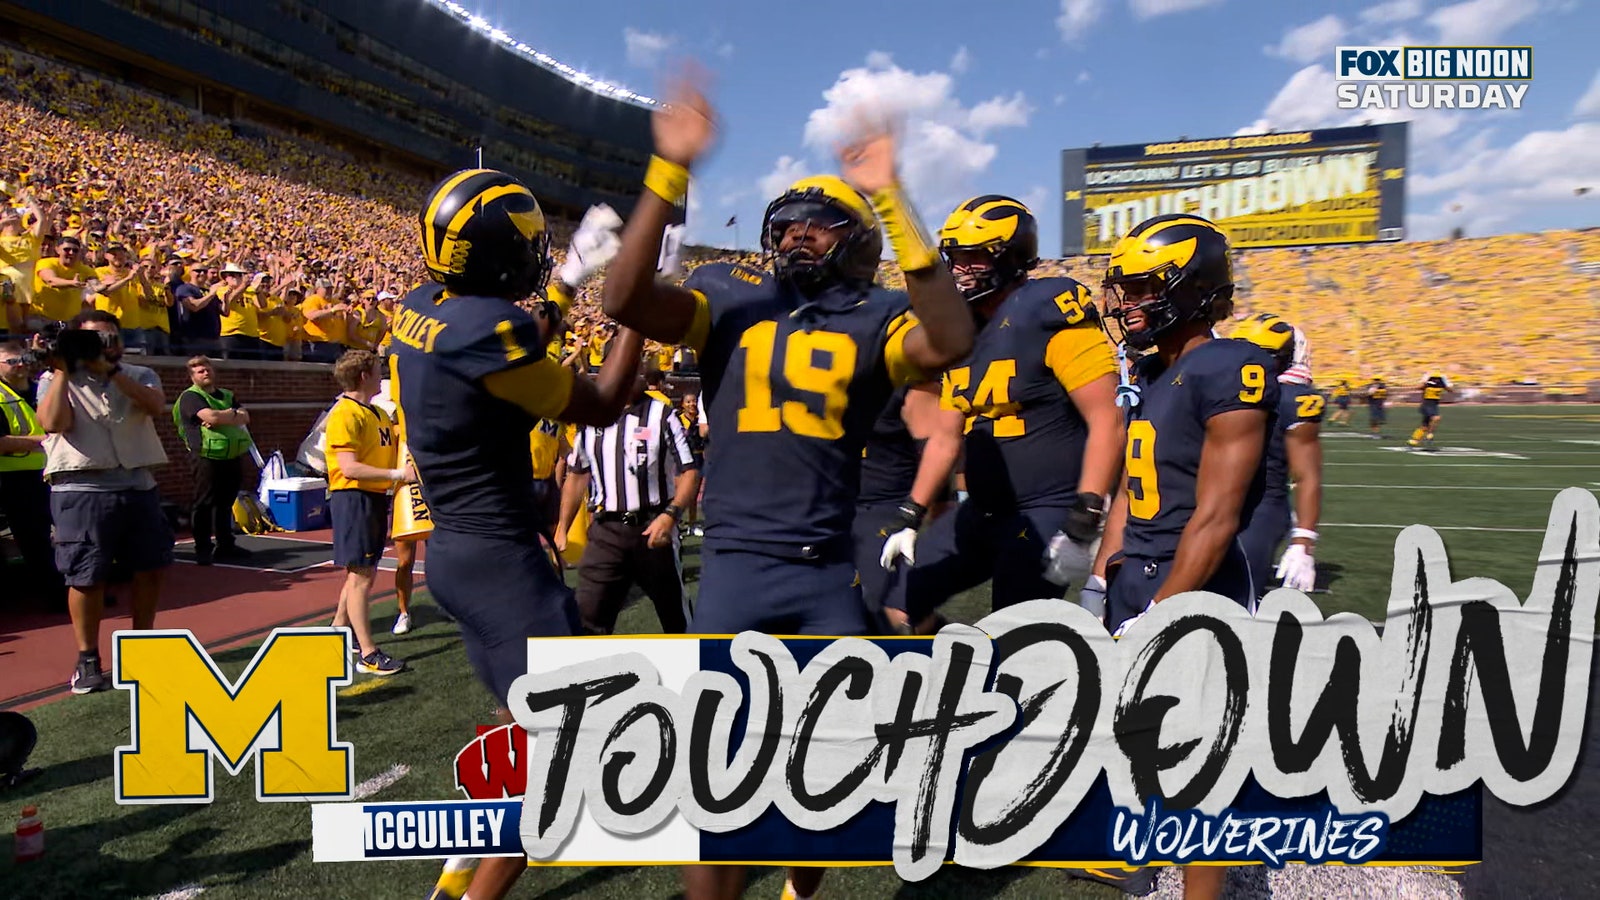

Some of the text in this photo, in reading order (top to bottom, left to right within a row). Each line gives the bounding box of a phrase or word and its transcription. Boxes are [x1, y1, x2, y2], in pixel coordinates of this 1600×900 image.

[495, 319, 527, 361] 1
[737, 319, 858, 440] 19
[1238, 364, 1265, 403] 9
[378, 427, 392, 446] M
[1126, 420, 1160, 520] 9
